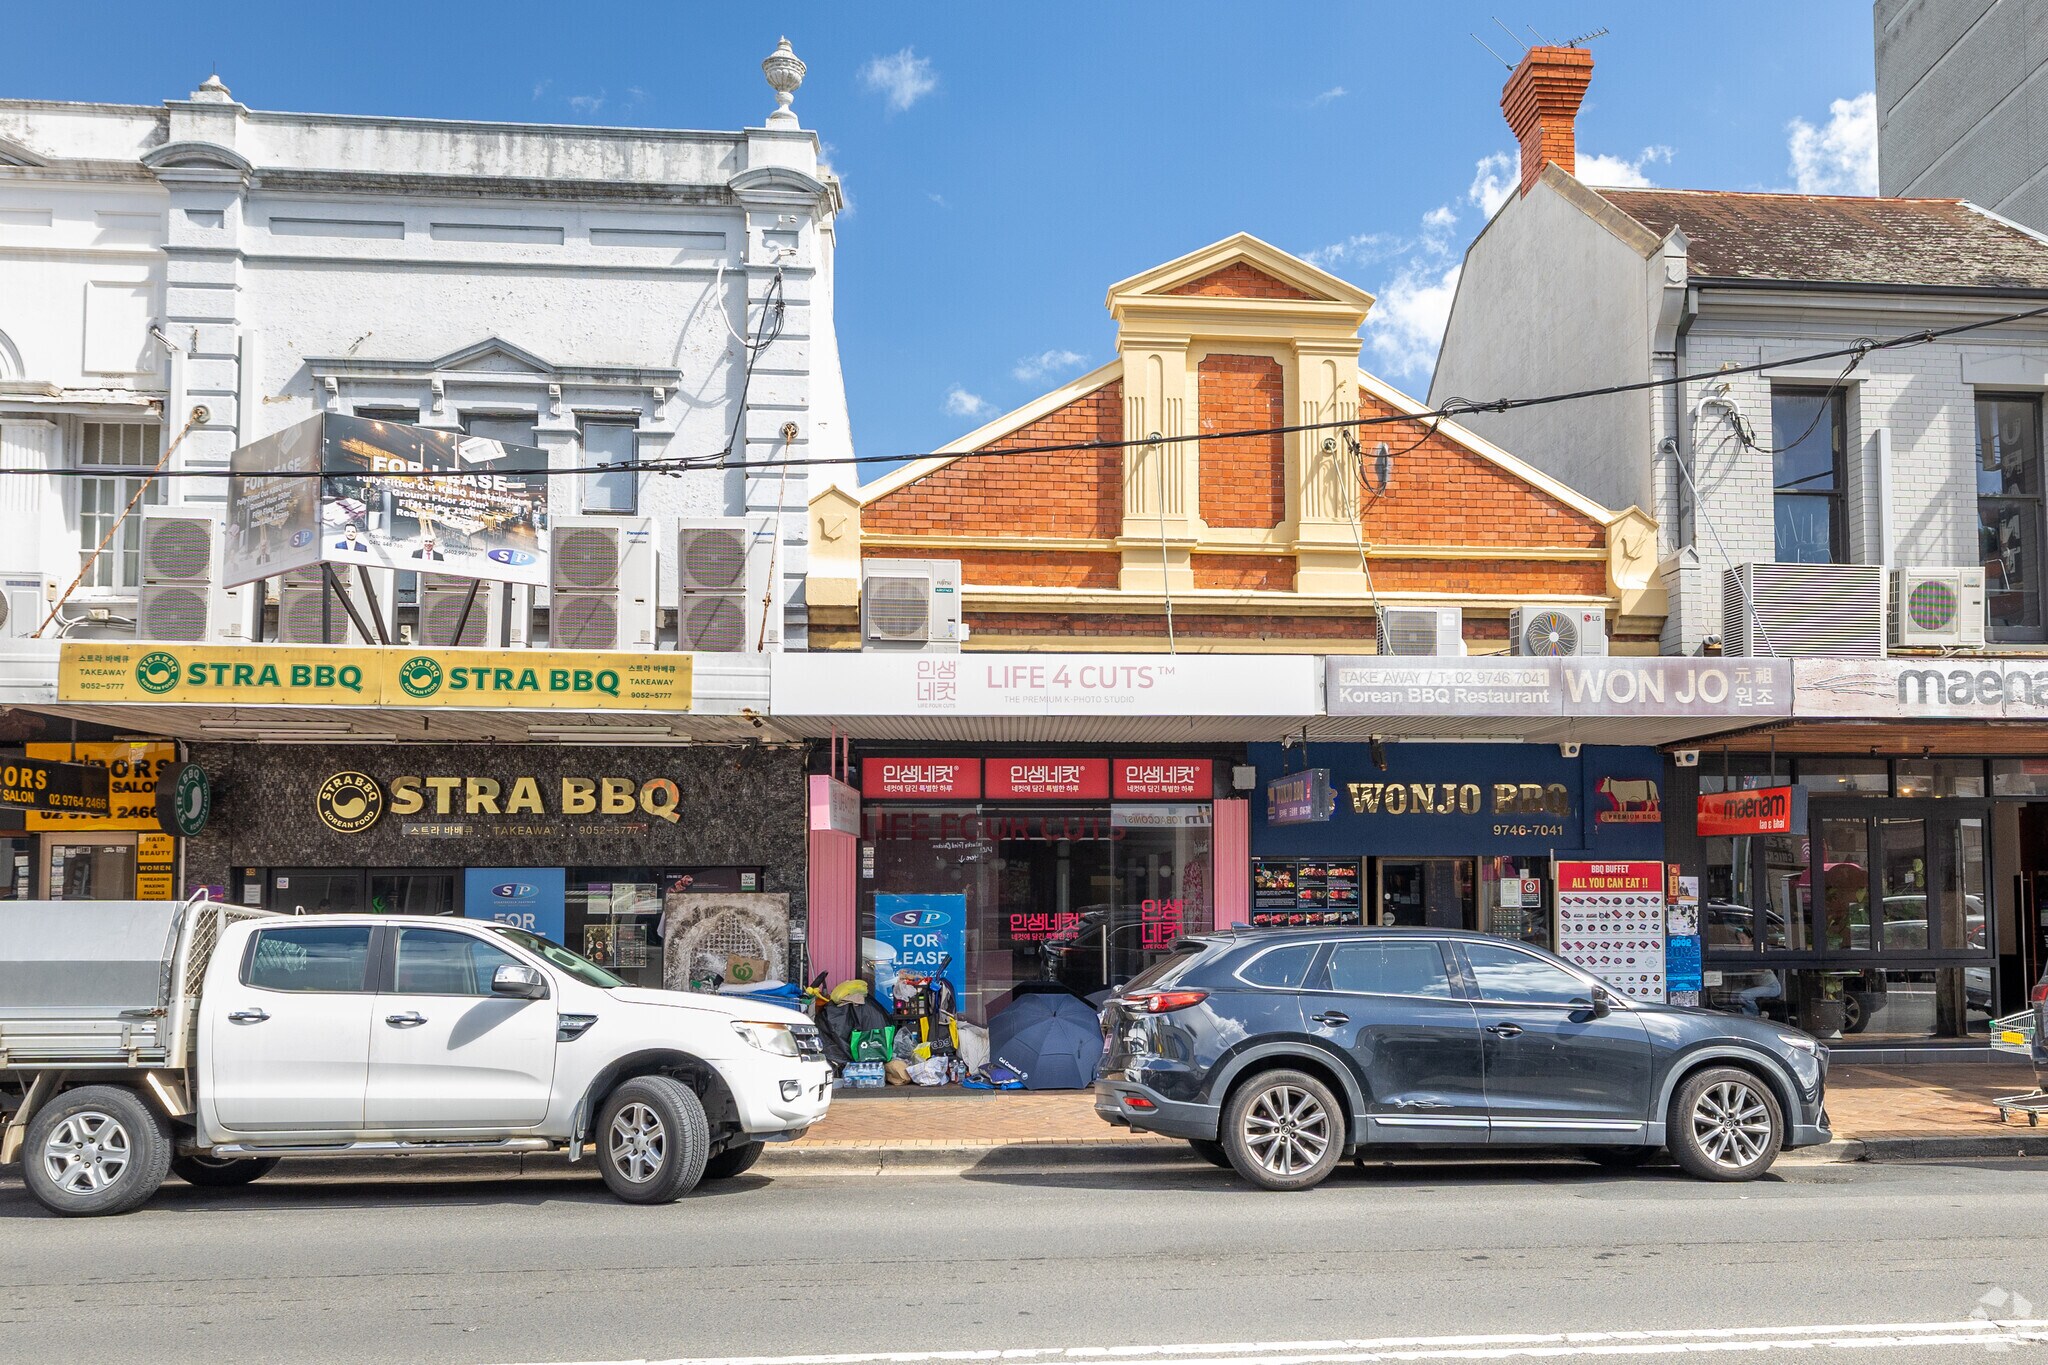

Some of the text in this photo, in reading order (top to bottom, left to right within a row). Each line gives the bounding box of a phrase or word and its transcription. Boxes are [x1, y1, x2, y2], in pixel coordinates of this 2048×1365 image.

[373, 455, 507, 492] FOR LEASE
[392, 488, 429, 500] Ground
[187, 662, 364, 694] STRA BBQ
[917, 661, 956, 680] 인생
[987, 666, 1044, 688] LIFE
[1052, 665, 1071, 688] 4
[1341, 671, 1377, 684] TAKE
[1383, 671, 1421, 684] AWAY
[1455, 671, 1472, 684] 02
[1478, 671, 1510, 684] 9746
[1515, 671, 1546, 684] 7041
[449, 667, 621, 698] STRA BBQ
[630, 678, 674, 686] TAKEAWAY
[917, 682, 956, 701] 네컷
[1565, 669, 1729, 703] WON JO
[1004, 695, 1135, 704] THE PREMIUM K-PHOTO STUDIO
[1339, 688, 1550, 703] Korean BBQ Restaurant
[112, 781, 157, 793] SALO
[322, 775, 378, 803] STRA BBQ
[3, 789, 107, 809] SALON 02 9764 2466
[390, 776, 681, 825] STRA BBQ
[1347, 783, 1572, 817] WONJO BBQ
[1724, 793, 1785, 820] maenam
[324, 810, 374, 829] KOREAN FOOD
[862, 813, 930, 841] LIFE
[940, 813, 1030, 841] FOUR
[410, 826, 474, 836] 스트라 바베큐
[493, 827, 558, 836] TAKEAWAY
[578, 826, 639, 836] 9052-5777
[1493, 824, 1564, 836] 9746-7041
[1591, 865, 1630, 874] BBQ BUFFET
[1572, 878, 1587, 889] ALL
[1589, 878, 1605, 888] YOU
[1607, 878, 1624, 888] CAN
[1625, 878, 1640, 888] EAT
[1142, 899, 1184, 921] 인생
[903, 934, 938, 947] FOR
[893, 951, 949, 965] LEASE
